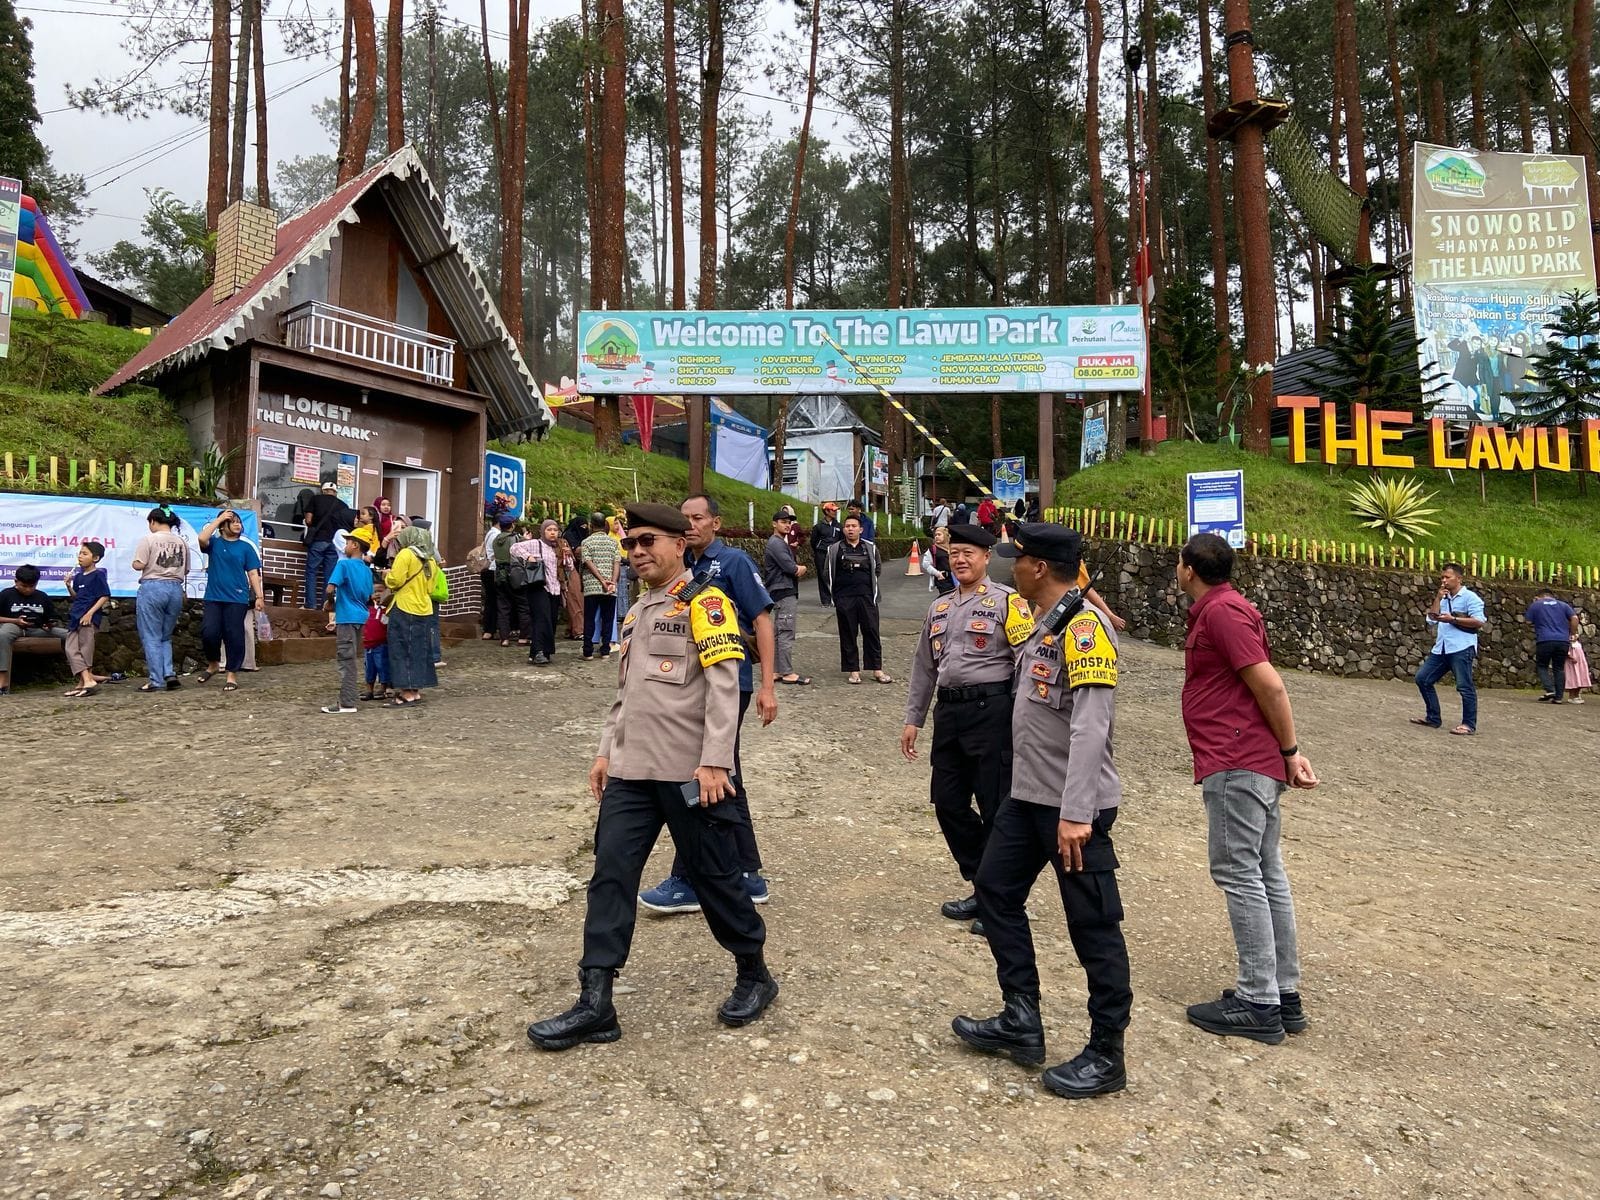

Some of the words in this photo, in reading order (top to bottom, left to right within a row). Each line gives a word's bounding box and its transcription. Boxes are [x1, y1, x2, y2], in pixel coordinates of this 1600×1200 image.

[1430, 210, 1577, 238] SNOWORLD
[1446, 238, 1500, 254] HANYA
[1507, 236, 1539, 251] ADA
[1546, 235, 1563, 249] DI
[1429, 257, 1466, 279] THE
[1471, 254, 1527, 277] LAWU
[1531, 251, 1582, 273] PARK
[1427, 294, 1459, 303] Rasakan
[1490, 293, 1523, 308] Hujan
[1526, 294, 1554, 308] Salju
[1468, 310, 1502, 320] Makan
[1505, 310, 1517, 321] Es
[1520, 311, 1548, 323] Serut
[653, 318, 783, 347] Welcome
[791, 319, 827, 347] To
[835, 318, 890, 346] The
[898, 318, 978, 345] Lawu
[987, 315, 1059, 344] Park
[677, 355, 721, 365] HIGHROPE
[761, 355, 814, 364] ADVENTURE
[855, 355, 886, 363] FLYING
[887, 355, 907, 363] FOX
[940, 354, 986, 363] JEMBATAN
[988, 354, 1011, 362] JALA
[1012, 353, 1043, 362] TUNDA
[1081, 358, 1108, 367] BUKA
[1110, 358, 1131, 366] JAM
[678, 366, 699, 375] SHOT
[702, 366, 736, 375] TARGET
[760, 366, 784, 375] PLAY
[786, 366, 822, 375] GROUND
[869, 366, 902, 374] CINEMA
[940, 365, 966, 374] SNOW
[968, 365, 991, 373] PARK
[993, 364, 1012, 373] DAN
[1013, 364, 1046, 373] WORLD
[1078, 369, 1104, 377] 08.00
[1112, 368, 1135, 376] 17.00
[677, 377, 696, 386] MINI
[696, 377, 716, 386] ZOO
[760, 377, 791, 386] CASTIL
[940, 376, 972, 385] HUMAN
[974, 376, 1000, 384] CLAW
[283, 394, 352, 421] LOKET
[257, 408, 284, 425] THE
[286, 414, 331, 434] LAWU
[1276, 395, 1415, 469] THE
[1428, 417, 1571, 472] LAWU
[489, 464, 518, 494] BRI
[25, 535, 57, 547] Fitri
[104, 538, 116, 548] H
[971, 610, 996, 619] POLRI
[653, 621, 686, 634] POLRI
[1035, 646, 1059, 661] POLRI
